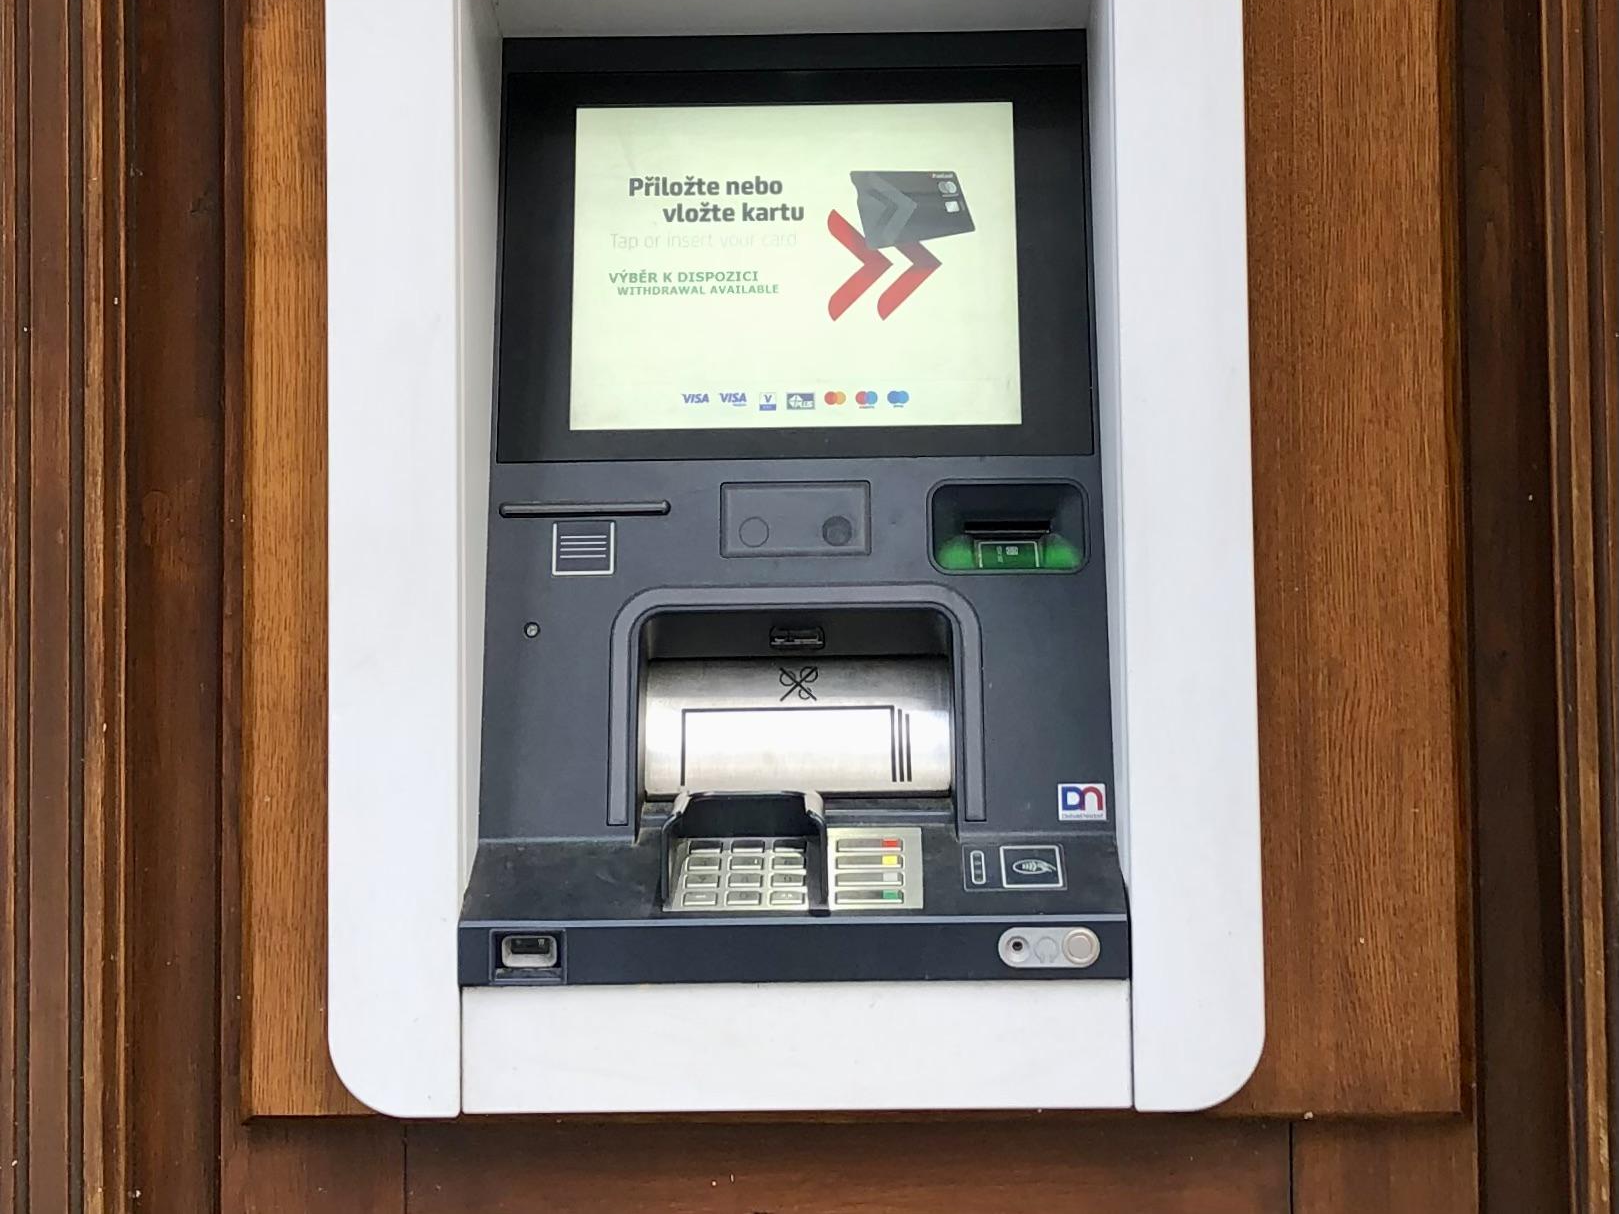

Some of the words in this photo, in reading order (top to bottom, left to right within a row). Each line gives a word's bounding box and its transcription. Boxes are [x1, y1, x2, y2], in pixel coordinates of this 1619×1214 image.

[628, 175, 720, 197] Přiložte
[726, 175, 783, 195] nebo
[662, 201, 735, 223] vložte
[742, 202, 805, 222] kartu
[610, 233, 639, 251] Tap
[644, 235, 664, 248] or
[608, 269, 658, 284] VÝBĚR
[663, 272, 672, 283] K
[677, 271, 758, 283] DISPOZICI
[617, 286, 706, 296] WITHDRAWAL
[710, 284, 779, 295] AVAILABLE
[681, 393, 710, 404] VISA
[718, 392, 747, 403] VISA
